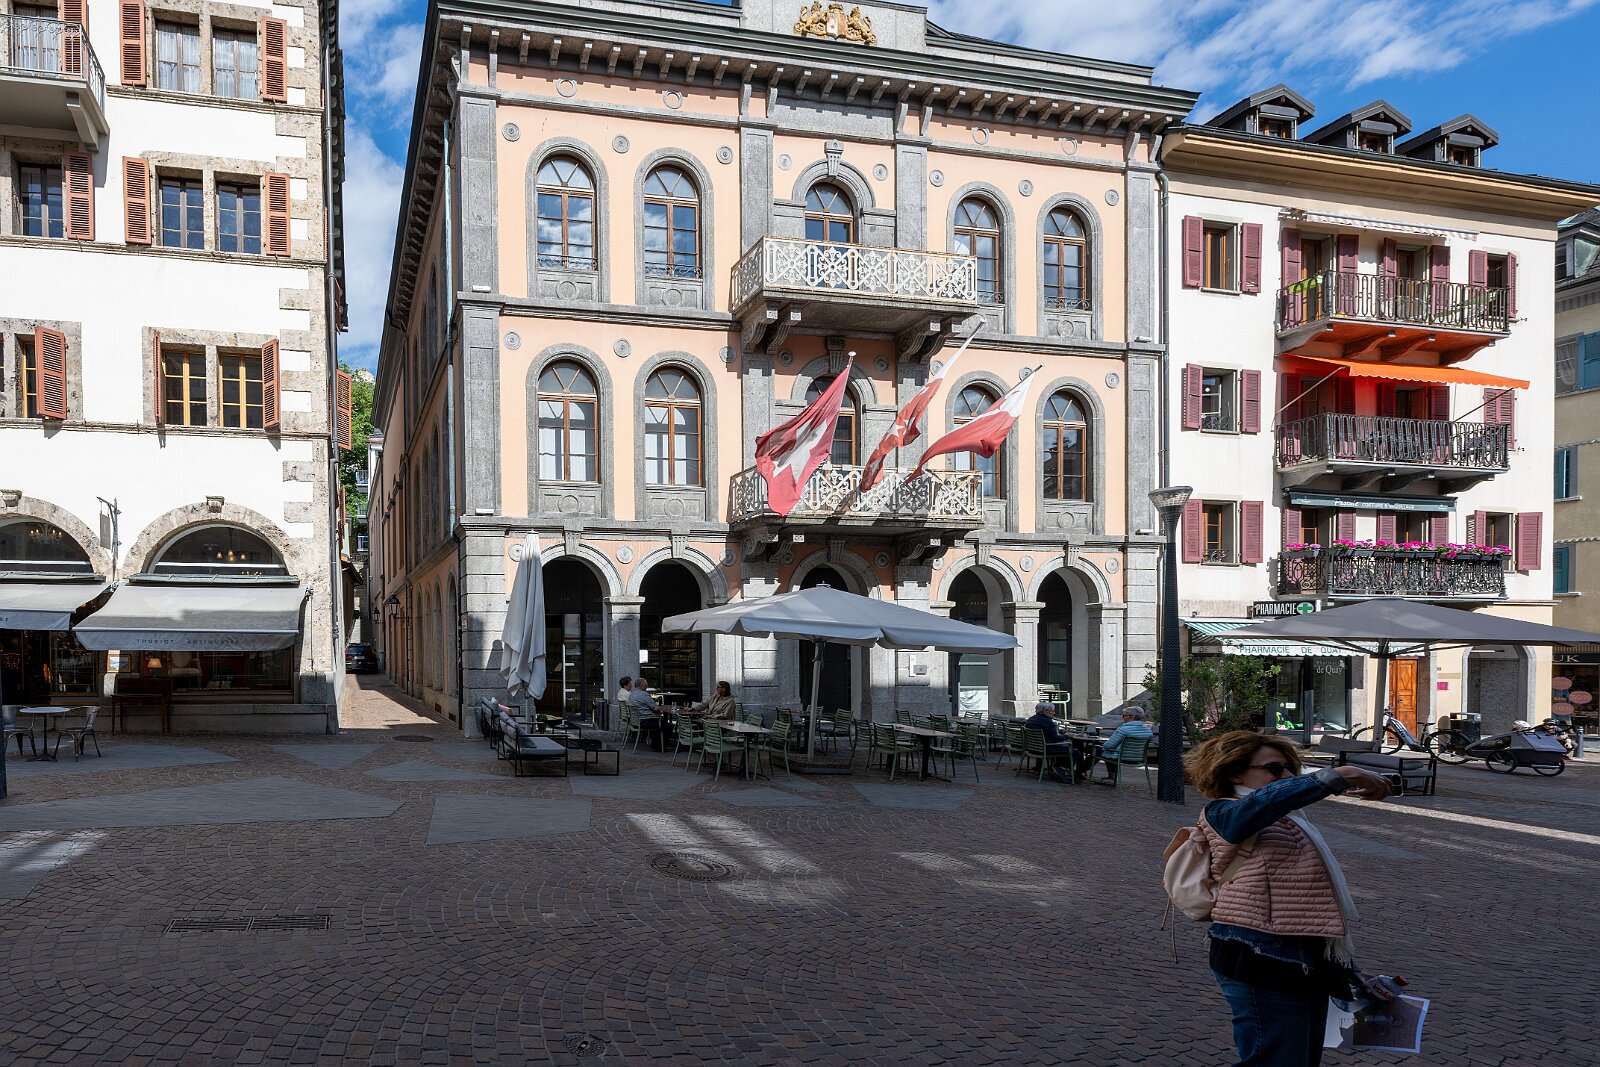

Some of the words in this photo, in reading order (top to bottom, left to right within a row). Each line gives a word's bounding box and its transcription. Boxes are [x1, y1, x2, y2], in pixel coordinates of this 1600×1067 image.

[1255, 602, 1297, 615] PHARMACIE
[1239, 646, 1290, 654] PHARMACIE
[1301, 646, 1313, 654] DE
[1316, 665, 1325, 673] de
[1325, 664, 1343, 675] Quay
